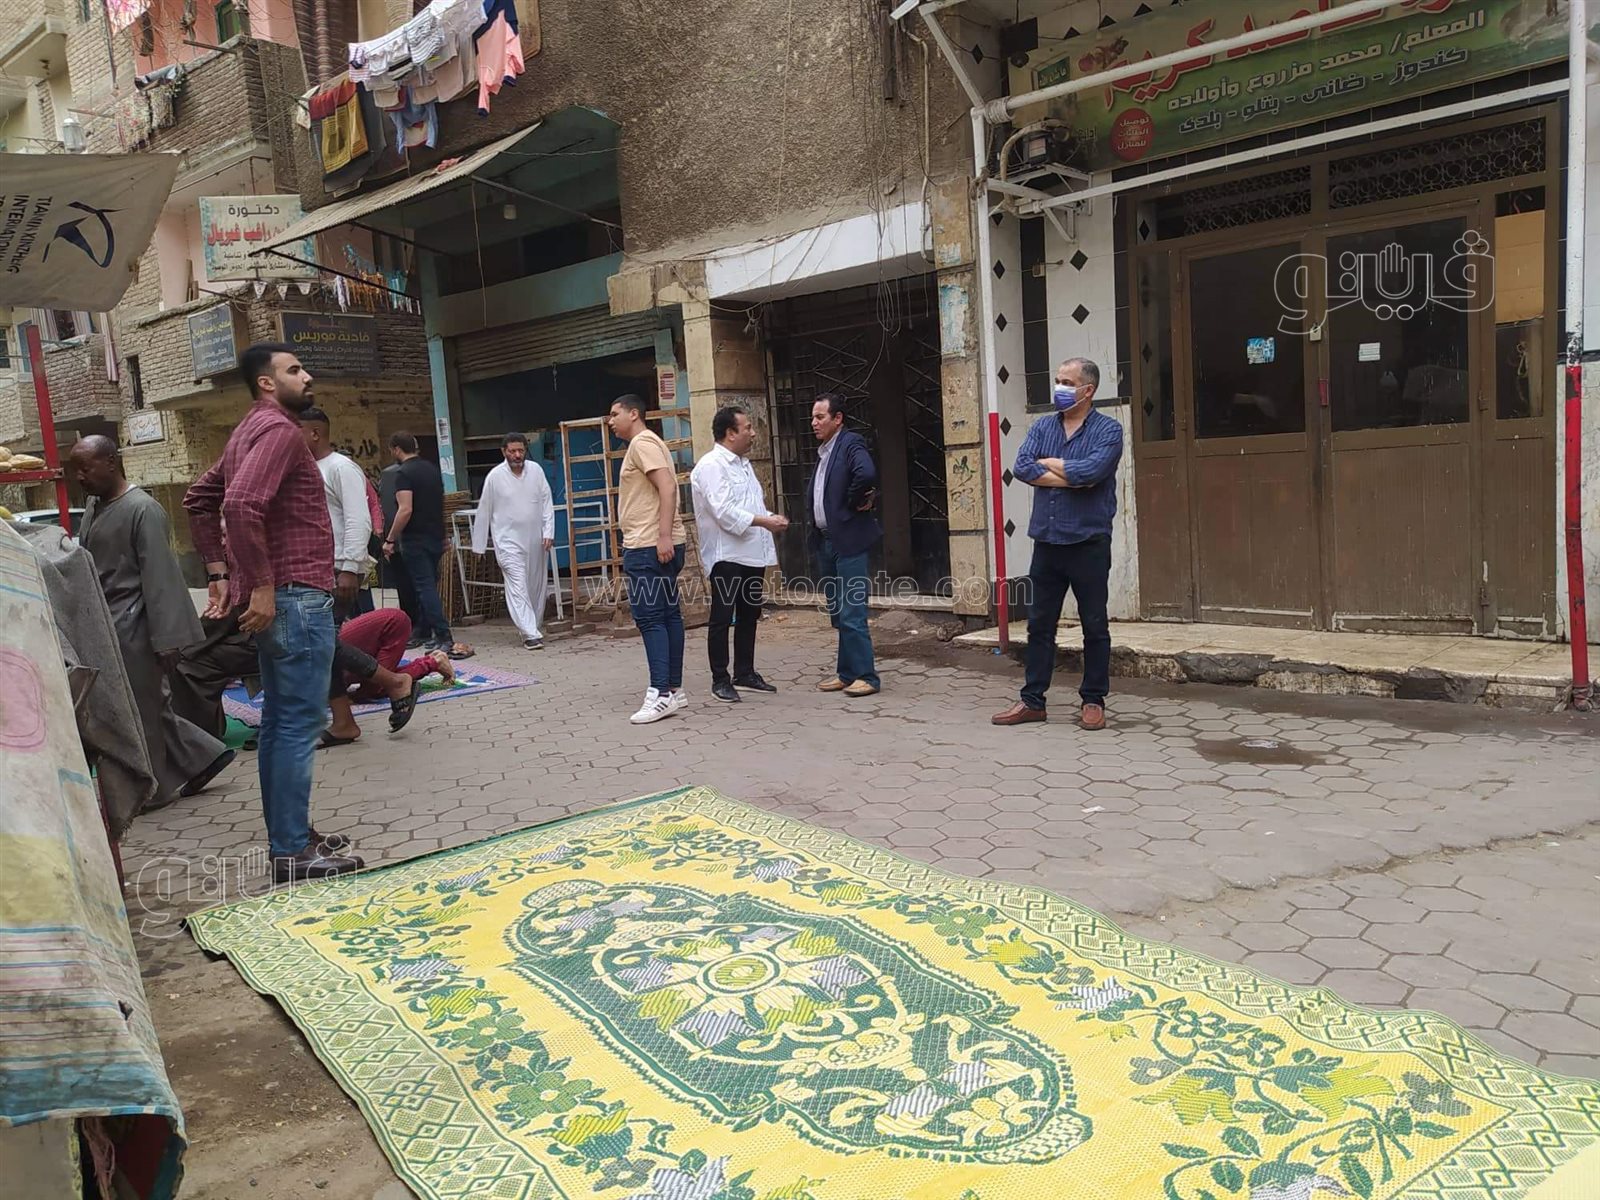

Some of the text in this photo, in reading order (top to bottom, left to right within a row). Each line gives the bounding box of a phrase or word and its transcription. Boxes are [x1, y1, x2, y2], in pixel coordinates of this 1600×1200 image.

[1319, 44, 1382, 71] محمد
[1389, 47, 1469, 85] كندوز
[1246, 62, 1312, 92] مزروع
[1168, 77, 1240, 110] وأولاده
[1242, 97, 1279, 121] بتلو
[1119, 116, 1149, 128] توصيل
[228, 204, 280, 217] دكتورة
[293, 331, 336, 343] موريس
